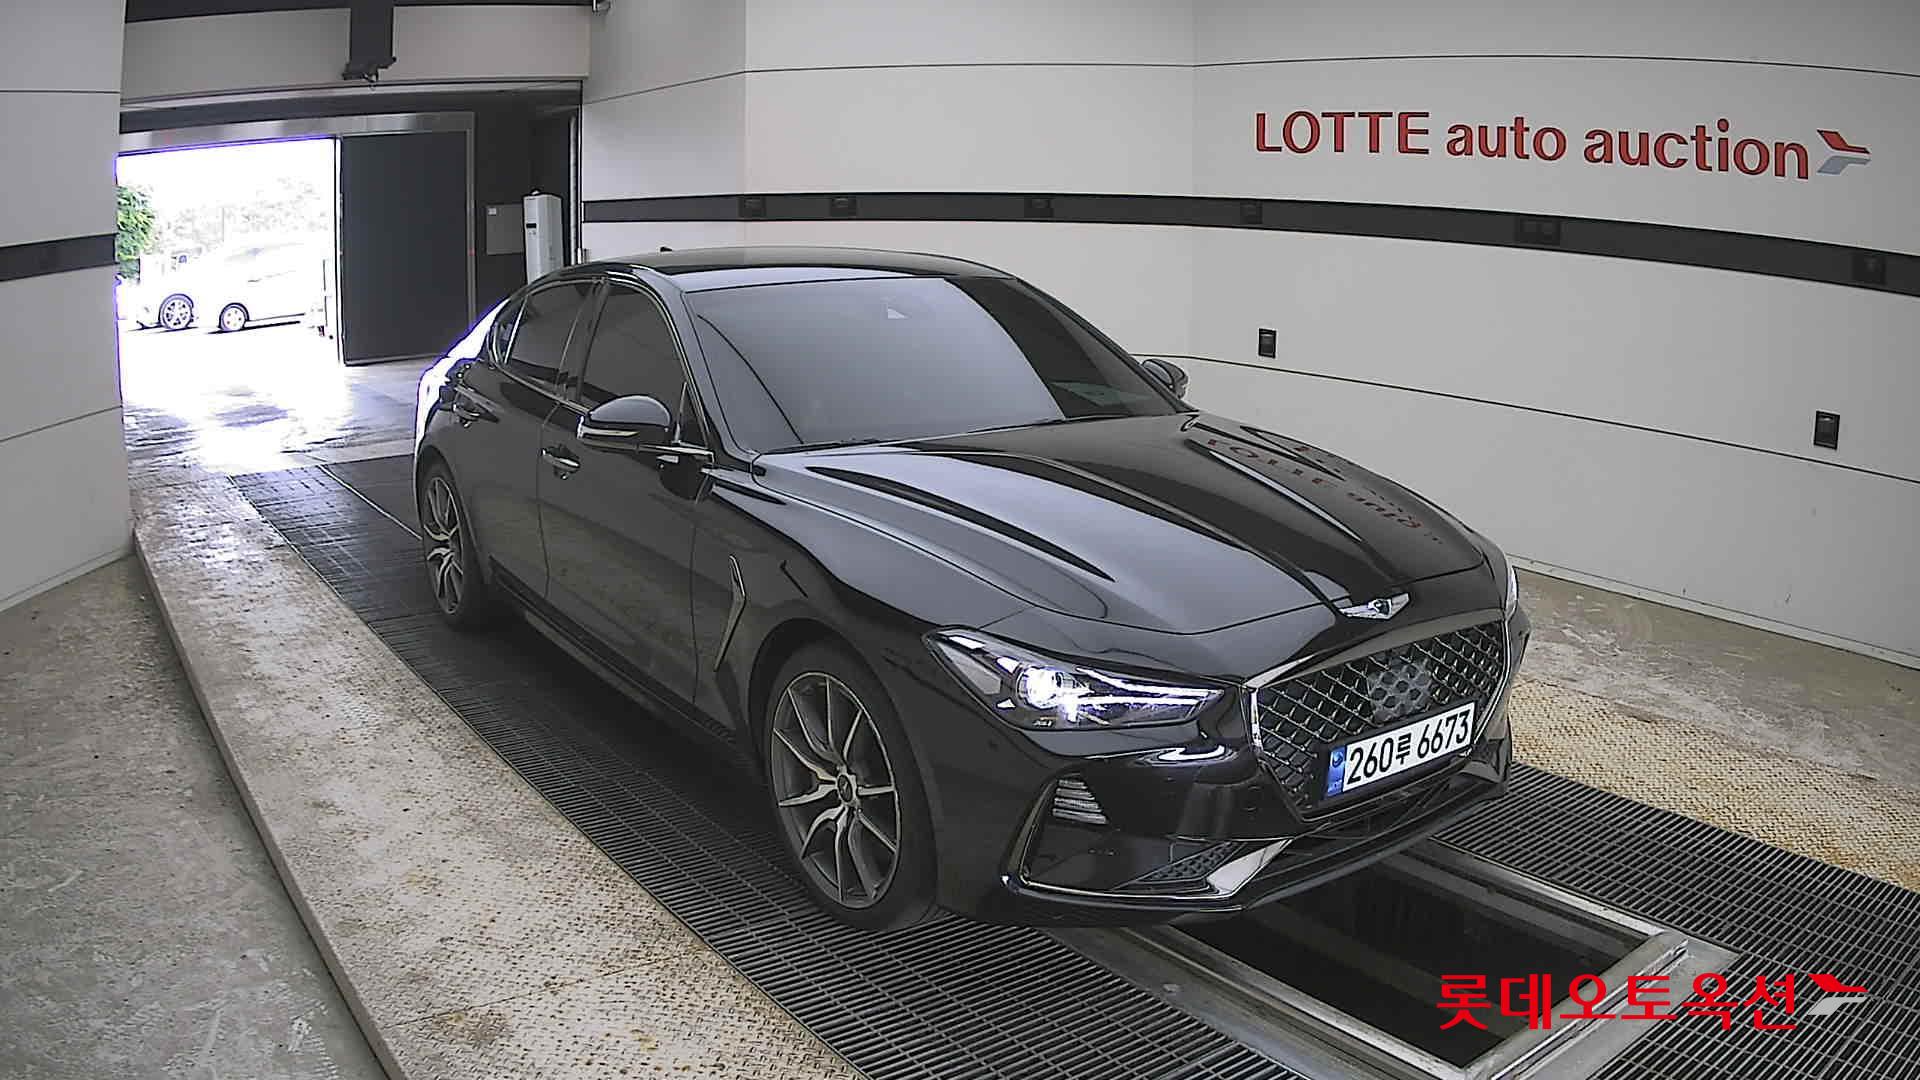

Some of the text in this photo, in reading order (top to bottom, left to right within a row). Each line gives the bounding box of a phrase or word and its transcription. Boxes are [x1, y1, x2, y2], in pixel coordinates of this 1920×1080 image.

[1255, 111, 1810, 180] LOTTE auto auction
[1347, 709, 1471, 784] 260루 6673
